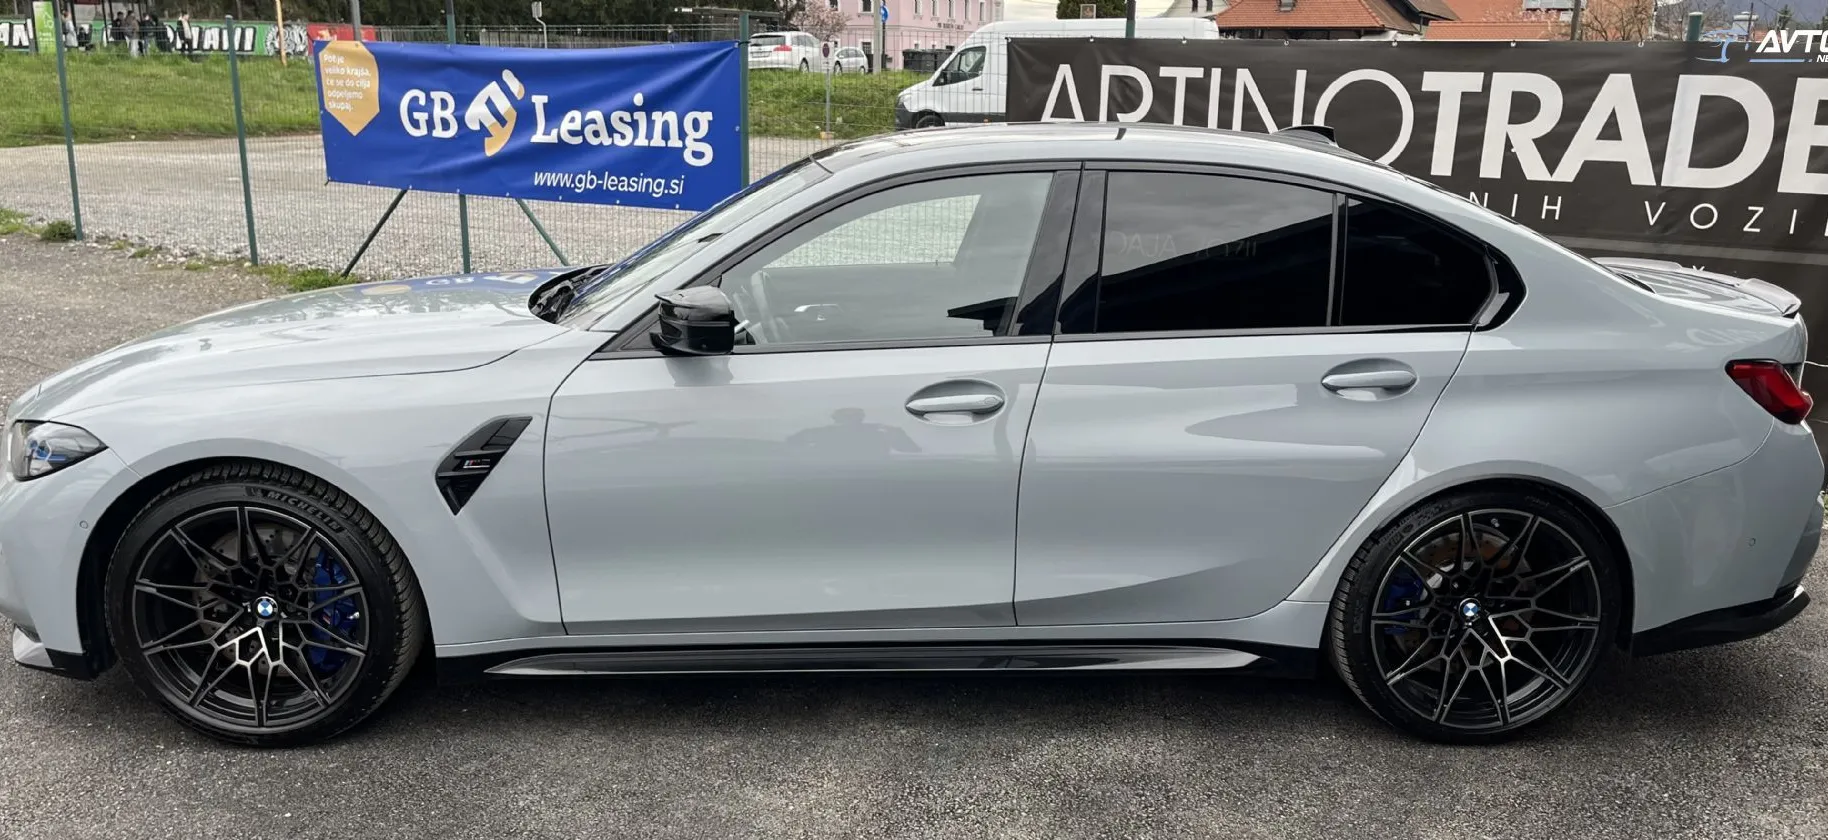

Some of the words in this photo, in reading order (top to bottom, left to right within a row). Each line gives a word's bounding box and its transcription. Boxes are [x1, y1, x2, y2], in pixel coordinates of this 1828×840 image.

[324, 55, 337, 63] Pot
[338, 56, 344, 64] je
[326, 66, 345, 75] veliko
[356, 80, 371, 89] cilja
[328, 90, 363, 100] odpeljemo
[400, 88, 459, 139] GB
[530, 92, 714, 167] Leasing
[533, 169, 685, 198] www.gb-leasing.si
[1644, 200, 1828, 238] VOZI
[266, 490, 341, 531] MICHELIN
